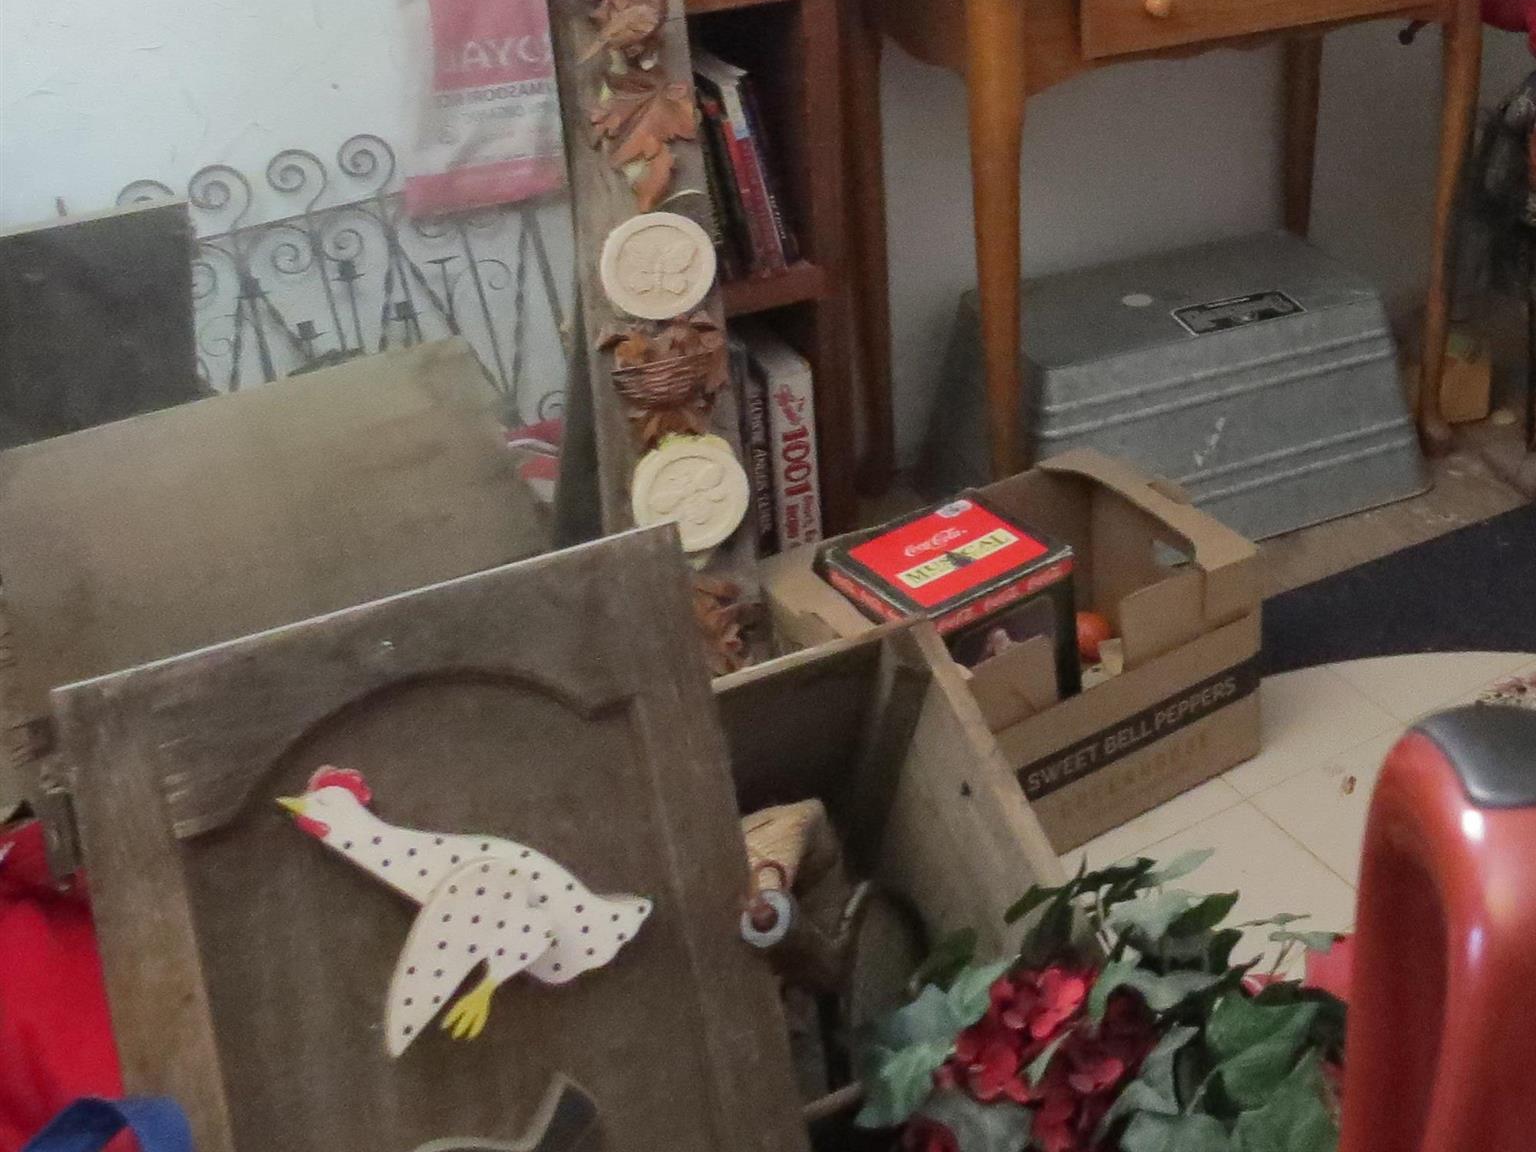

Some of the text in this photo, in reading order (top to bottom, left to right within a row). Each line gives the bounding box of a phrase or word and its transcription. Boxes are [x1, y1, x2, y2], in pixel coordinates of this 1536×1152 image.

[782, 425, 813, 498] 1001
[904, 534, 1008, 584] MUSCAL
[1027, 743, 1099, 791] SWEET
[1103, 719, 1152, 755] BELL
[1154, 677, 1237, 731] PEPPERS
